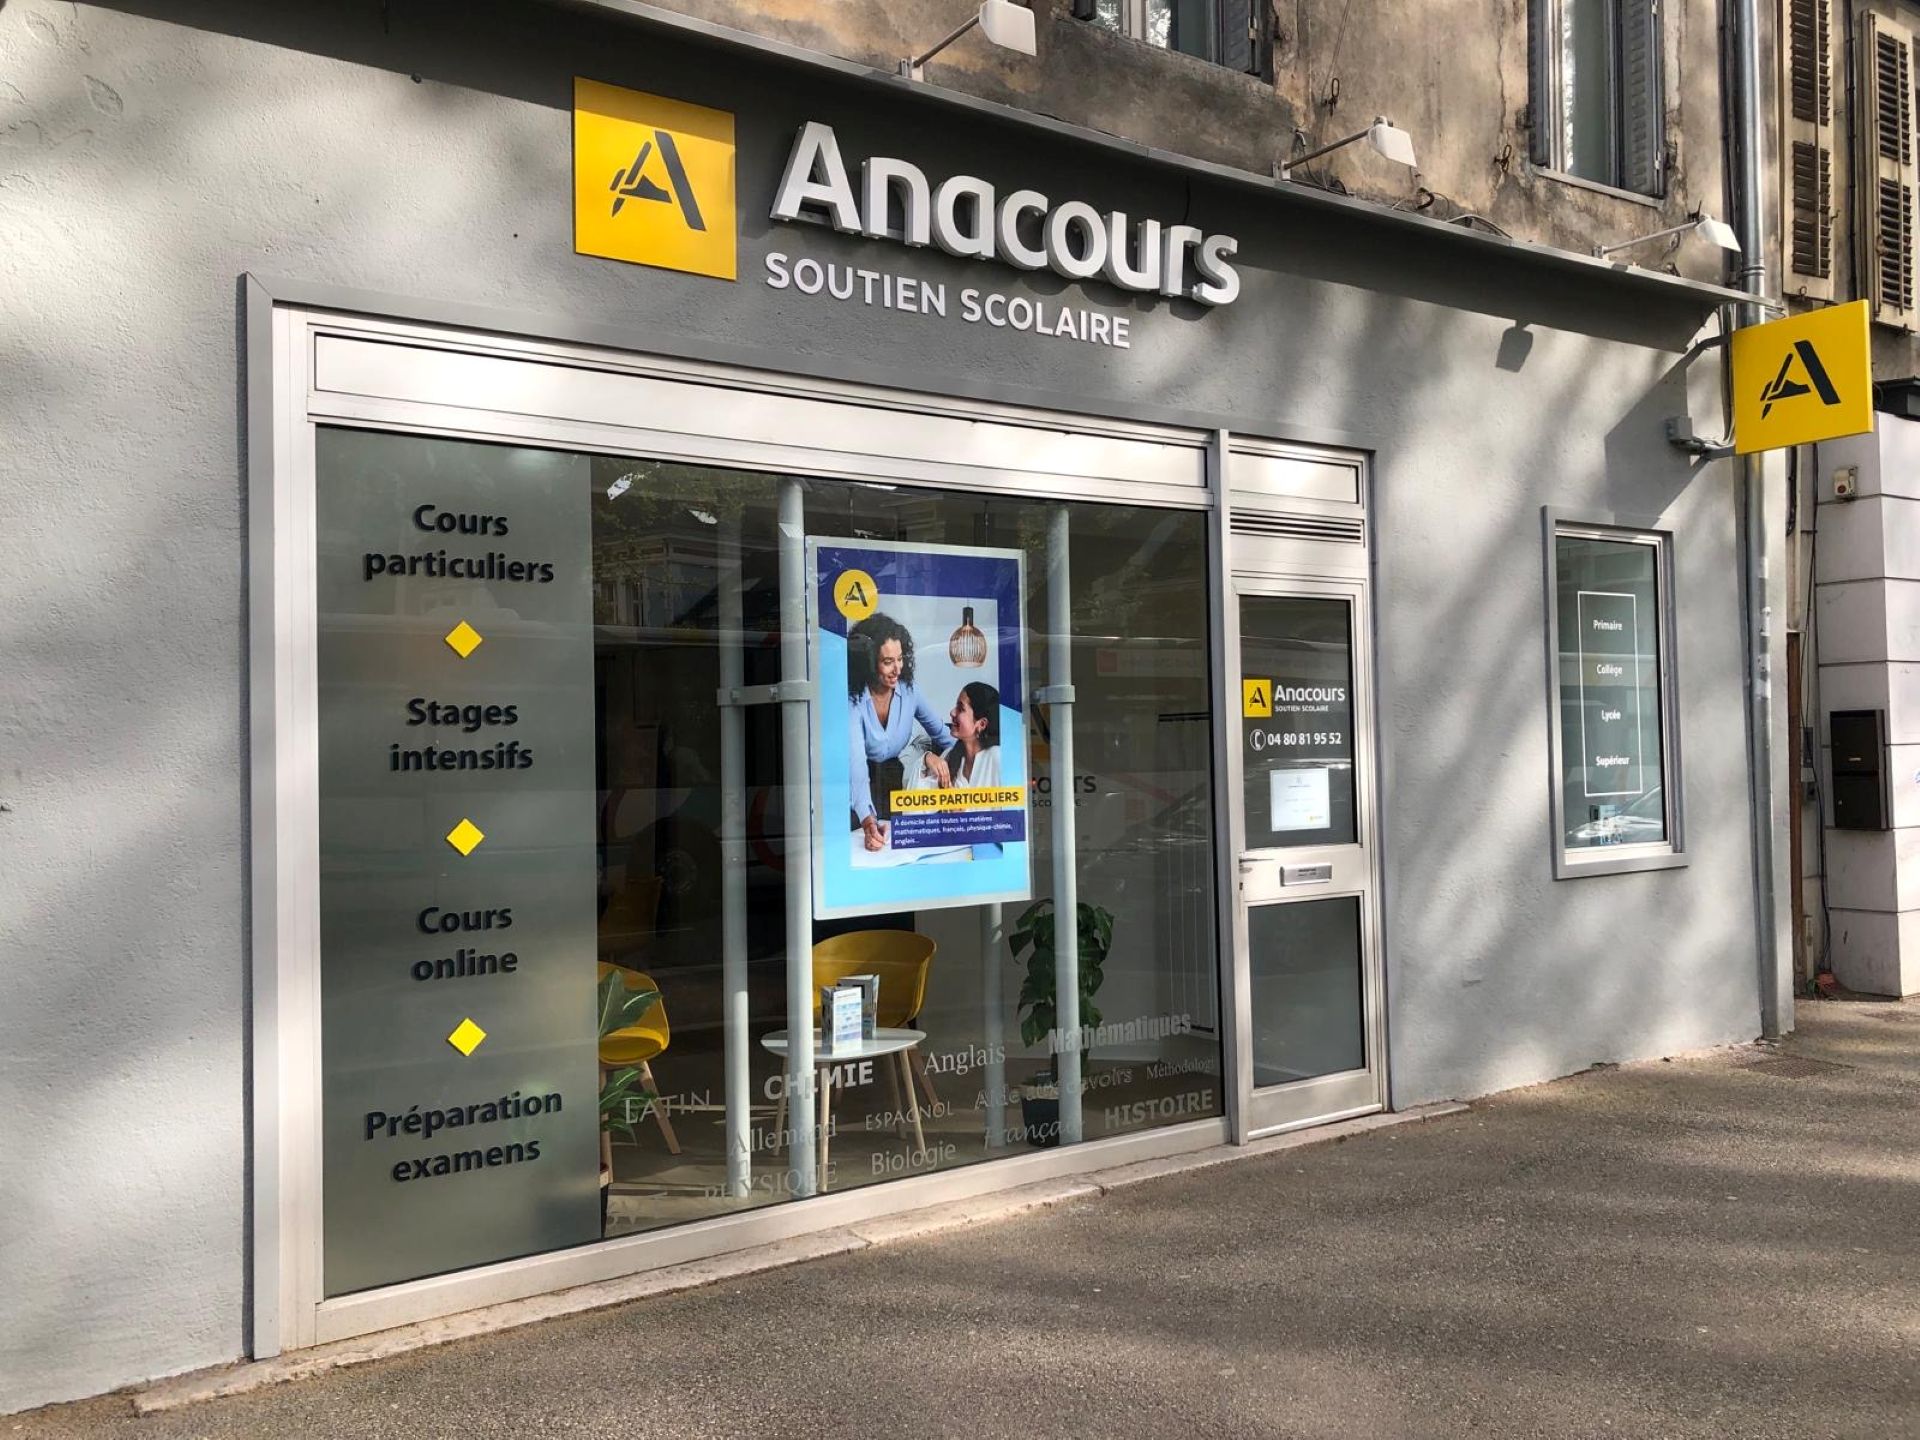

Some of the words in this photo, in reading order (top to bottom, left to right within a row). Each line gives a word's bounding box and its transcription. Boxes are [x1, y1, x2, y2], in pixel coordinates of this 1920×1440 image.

[769, 120, 1240, 307] Anacours
[765, 252, 946, 317] SOUTIEN
[960, 288, 1131, 349] SCOLAIRE
[413, 503, 509, 537] Cours
[363, 550, 555, 583] particuliers
[1593, 619, 1623, 632] Primaire
[1596, 663, 1623, 676] Collège
[1274, 684, 1346, 702] Anacours
[1274, 704, 1301, 713] SOUTIEN
[1301, 704, 1329, 712] SCOLAIRE
[405, 697, 519, 733] Stages
[1601, 709, 1622, 722] Lycée
[389, 740, 534, 772] intensifs
[1267, 733, 1281, 746] 04
[1283, 733, 1297, 746] 80
[1298, 733, 1311, 746] 81
[1313, 732, 1327, 745] 95
[1328, 732, 1342, 745] 52
[895, 795, 937, 807] COURS
[939, 791, 1020, 806] PARTICULIERS
[415, 906, 513, 935] Cours
[410, 948, 519, 982] online
[1048, 1013, 1192, 1054] Mathématiques
[924, 1042, 1006, 1076] Anglais
[763, 1060, 873, 1100] CHIMIE
[363, 1090, 563, 1141] Préparation
[625, 1088, 710, 1124] LATIN
[865, 1100, 954, 1131] ESPAGNOL
[1104, 1088, 1213, 1130] HISTOIRE
[391, 1138, 541, 1182] examens
[871, 1140, 956, 1175] Biologie
